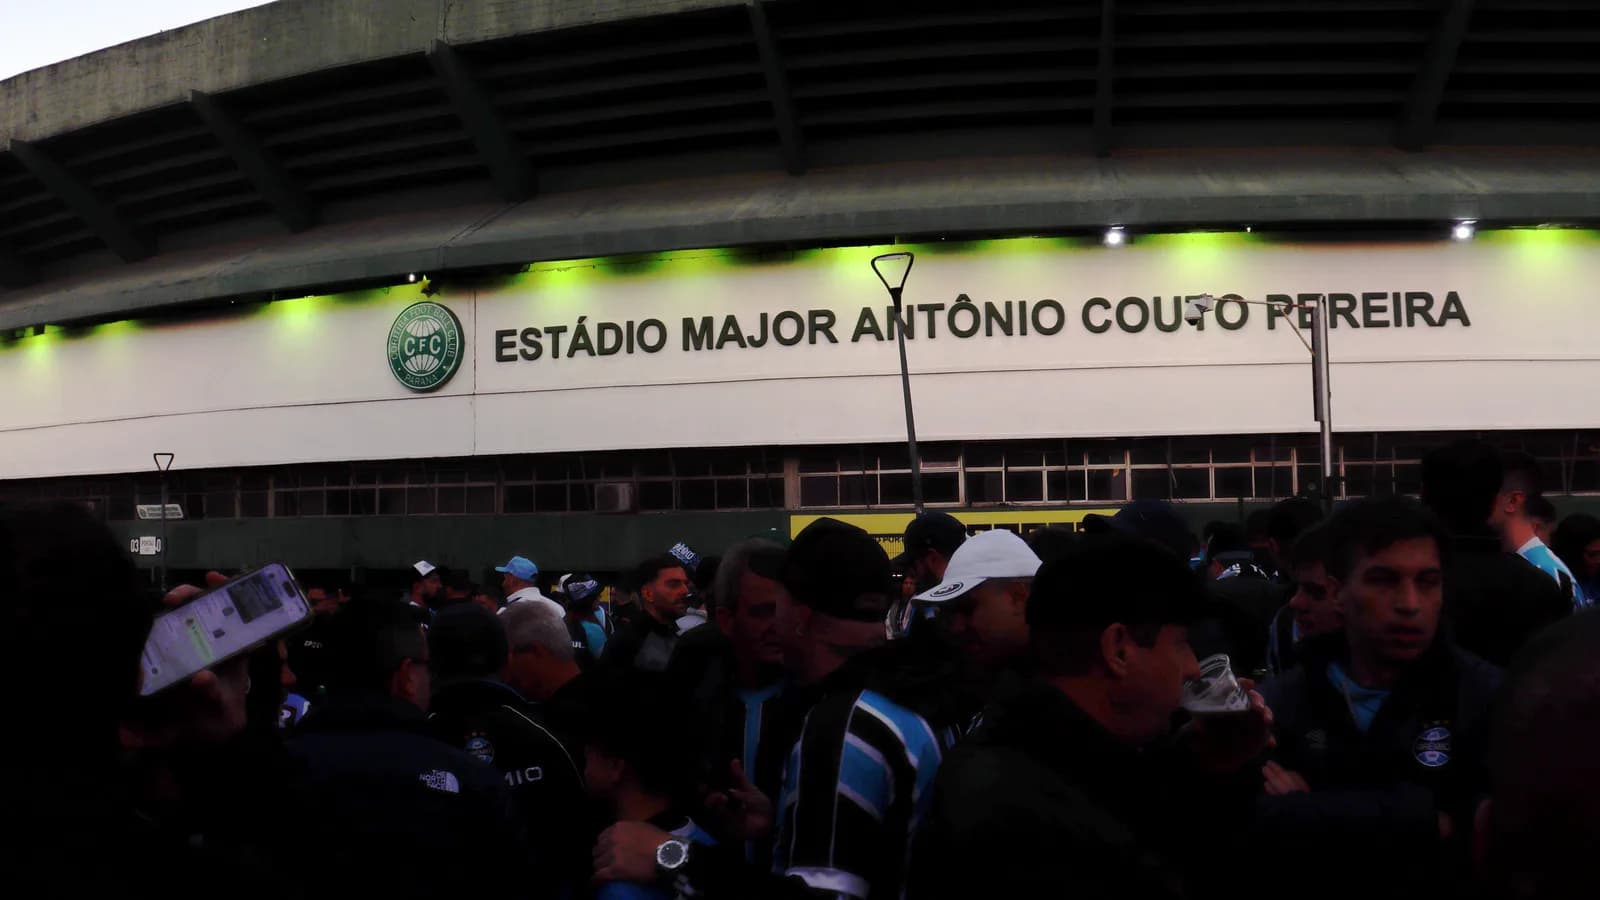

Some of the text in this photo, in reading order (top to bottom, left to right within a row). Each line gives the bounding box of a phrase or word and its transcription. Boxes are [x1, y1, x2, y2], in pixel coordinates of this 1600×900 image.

[495, 291, 1471, 362] ESTÁDIO MAJOR ANTÔNIO COUTO PEREIRA
[404, 335, 441, 356] CFC
[447, 329, 456, 358] CLUB
[130, 539, 139, 552] 03
